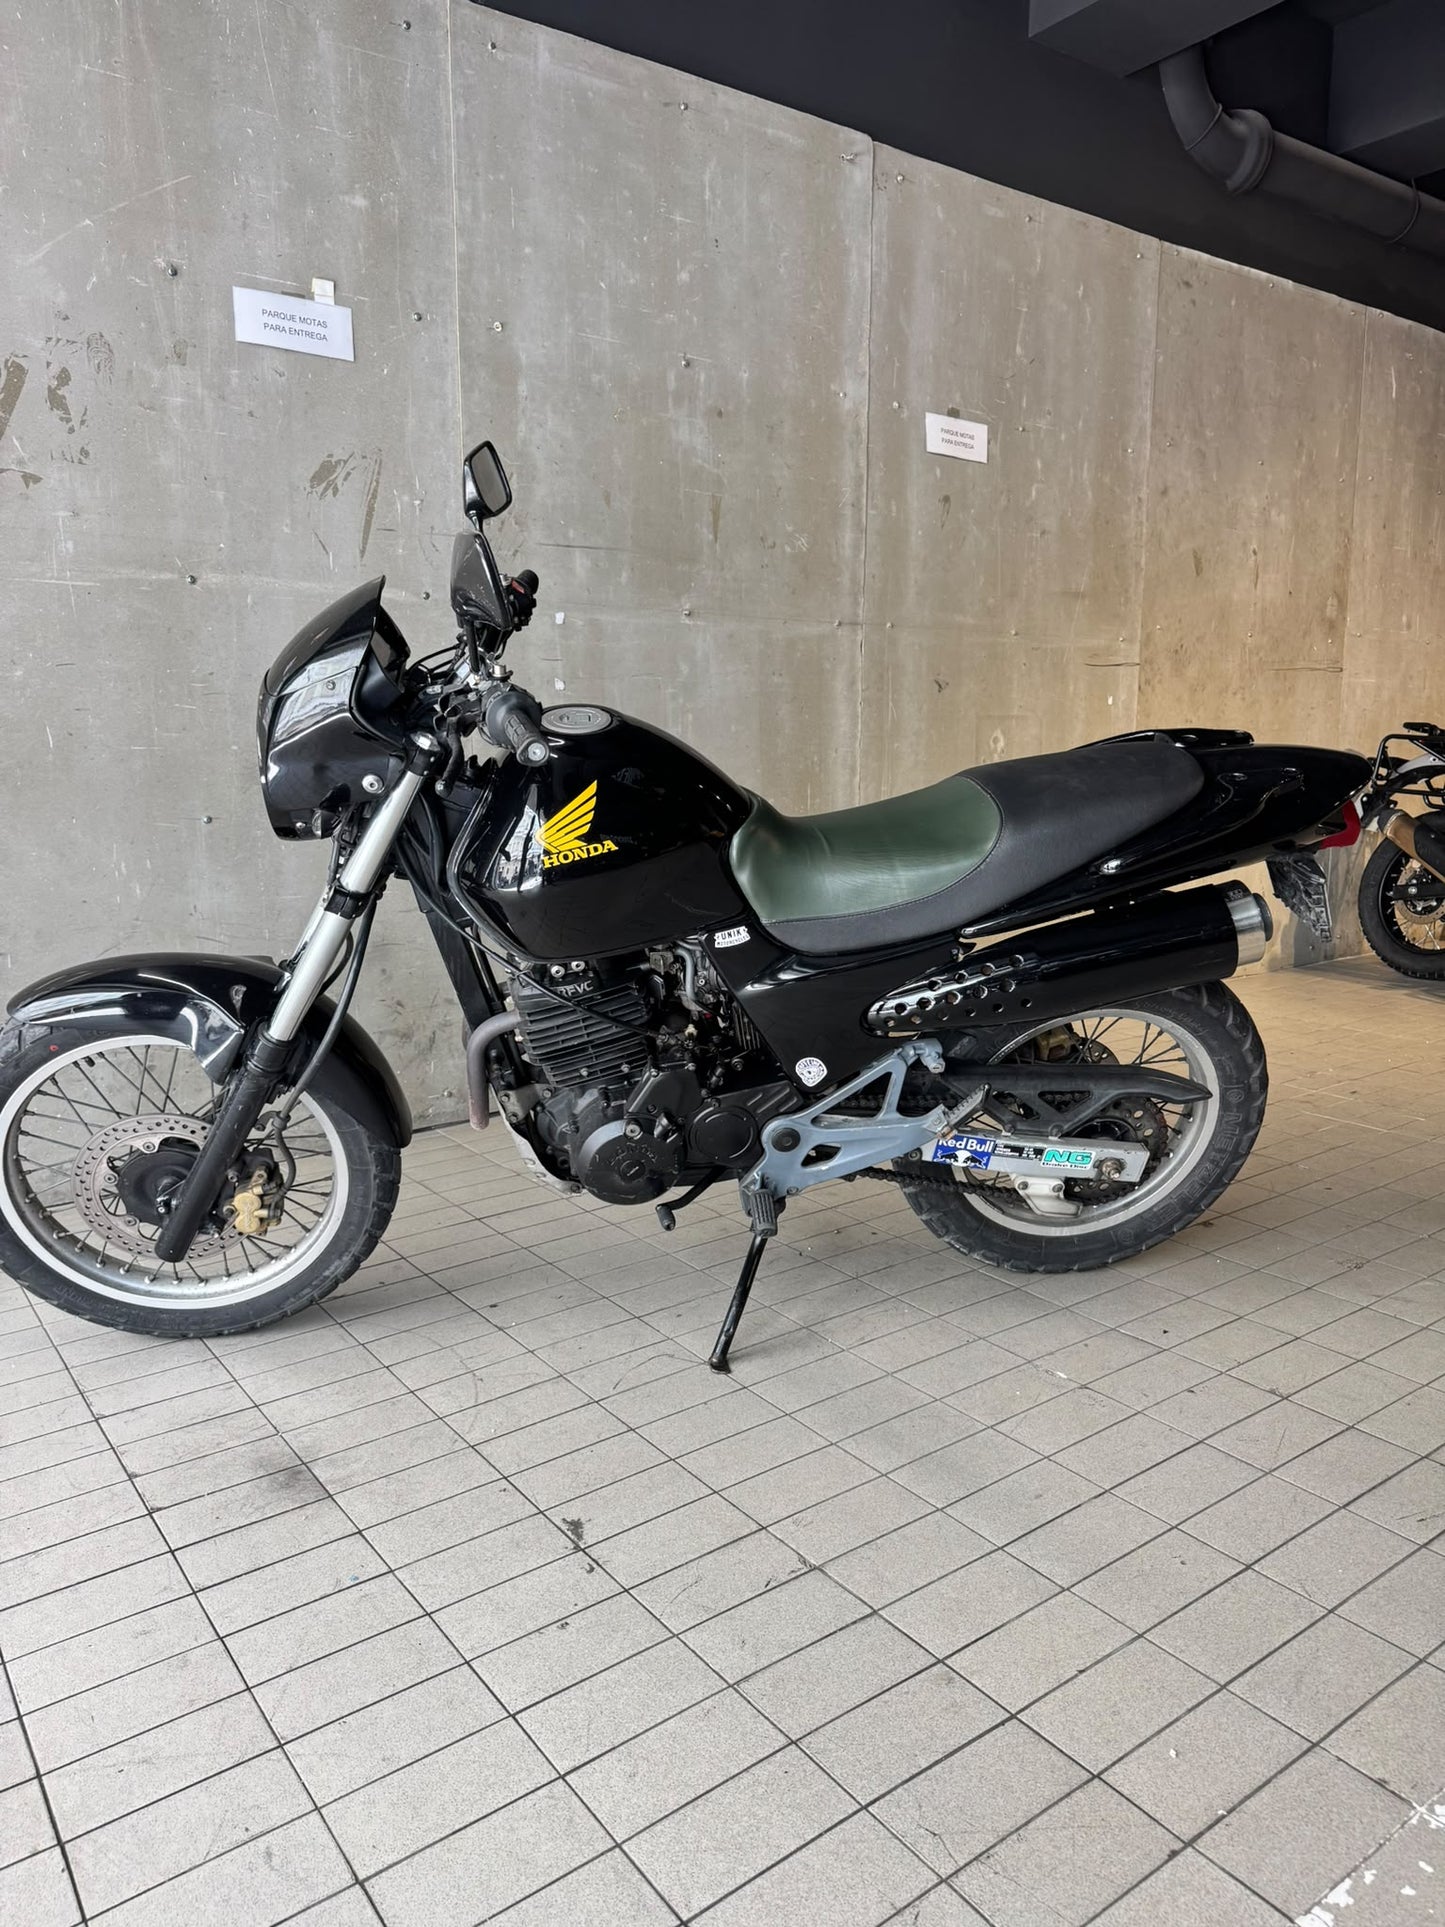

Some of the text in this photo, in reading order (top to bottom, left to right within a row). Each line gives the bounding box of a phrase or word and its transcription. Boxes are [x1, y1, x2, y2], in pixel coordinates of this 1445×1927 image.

[261, 308, 328, 329] PARQUE MOTAS
[263, 322, 328, 342] PARA ENTREGA
[541, 840, 619, 868] HONDA
[558, 980, 594, 997] RFVC
[966, 1138, 995, 1153] Bull
[1044, 1149, 1093, 1165] NG
